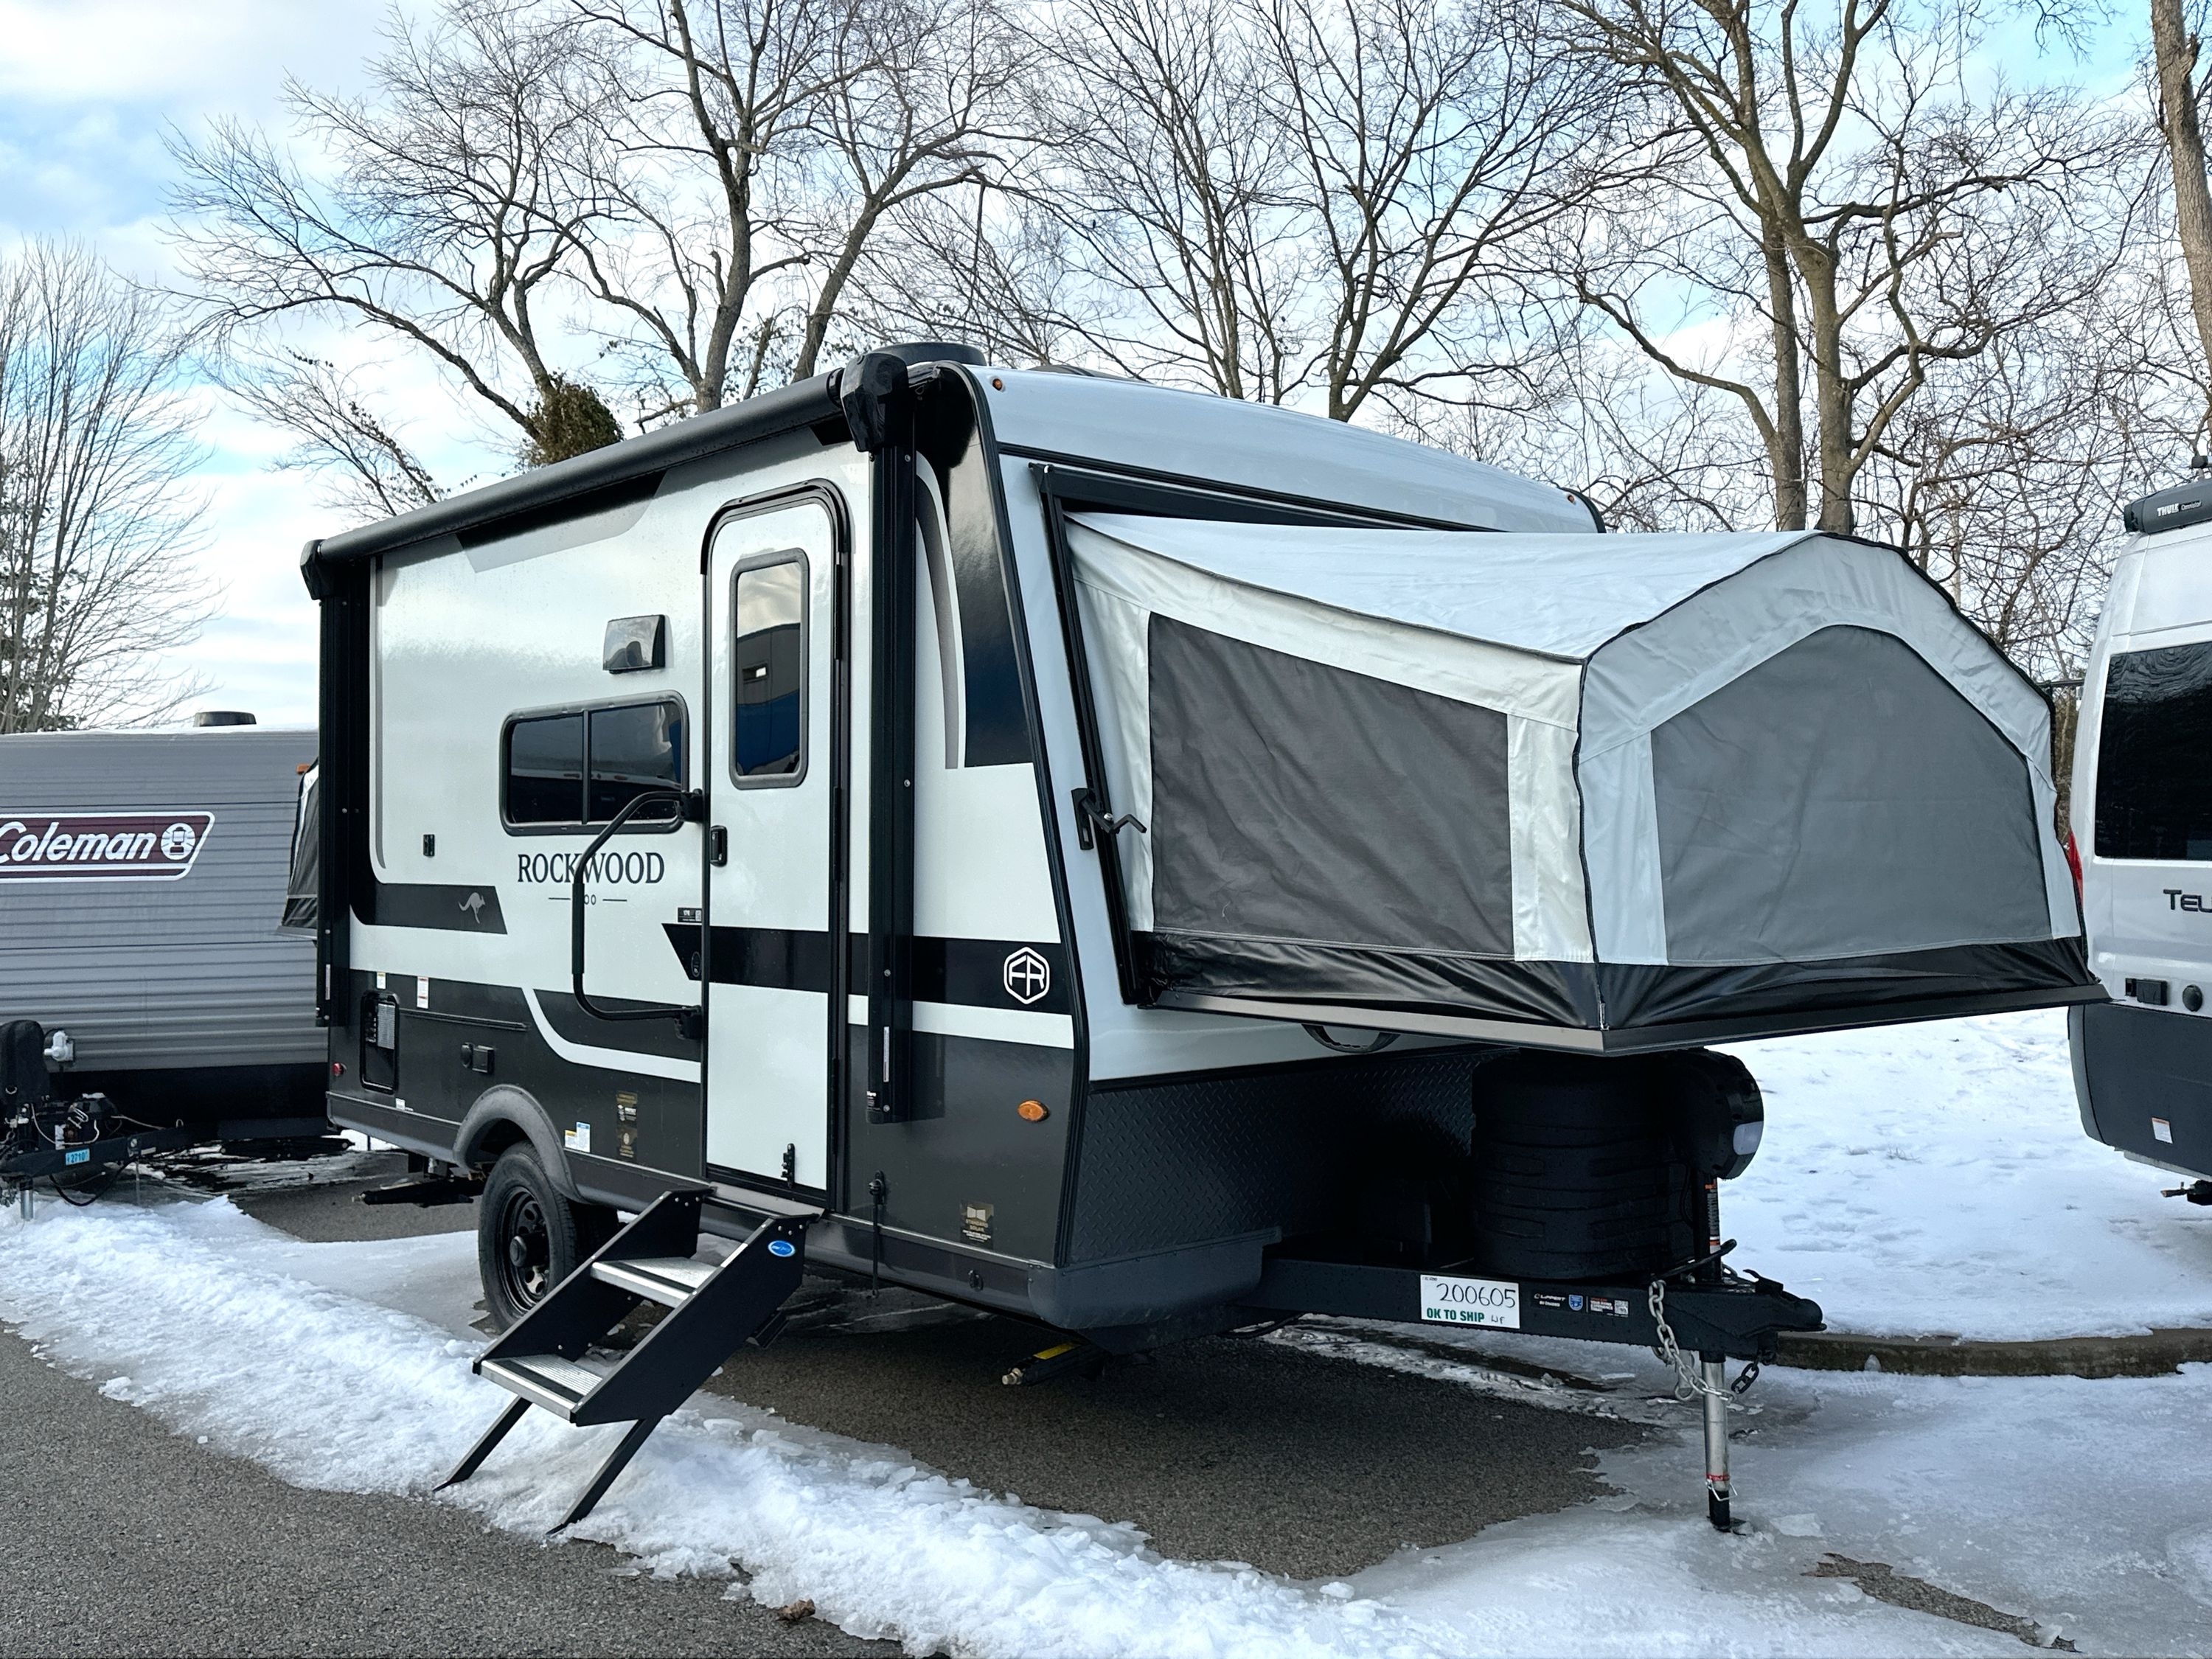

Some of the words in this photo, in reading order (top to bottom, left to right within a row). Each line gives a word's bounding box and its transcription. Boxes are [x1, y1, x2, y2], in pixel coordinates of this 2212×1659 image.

[2157, 503, 2180, 517] THULE
[0, 821, 157, 864] Coleman
[518, 852, 664, 884] ROCKWOOD
[1436, 1283, 1516, 1308] 200605
[1426, 1307, 1441, 1319] OK
[1444, 1309, 1457, 1321] TO
[1460, 1310, 1485, 1323] SHIP
